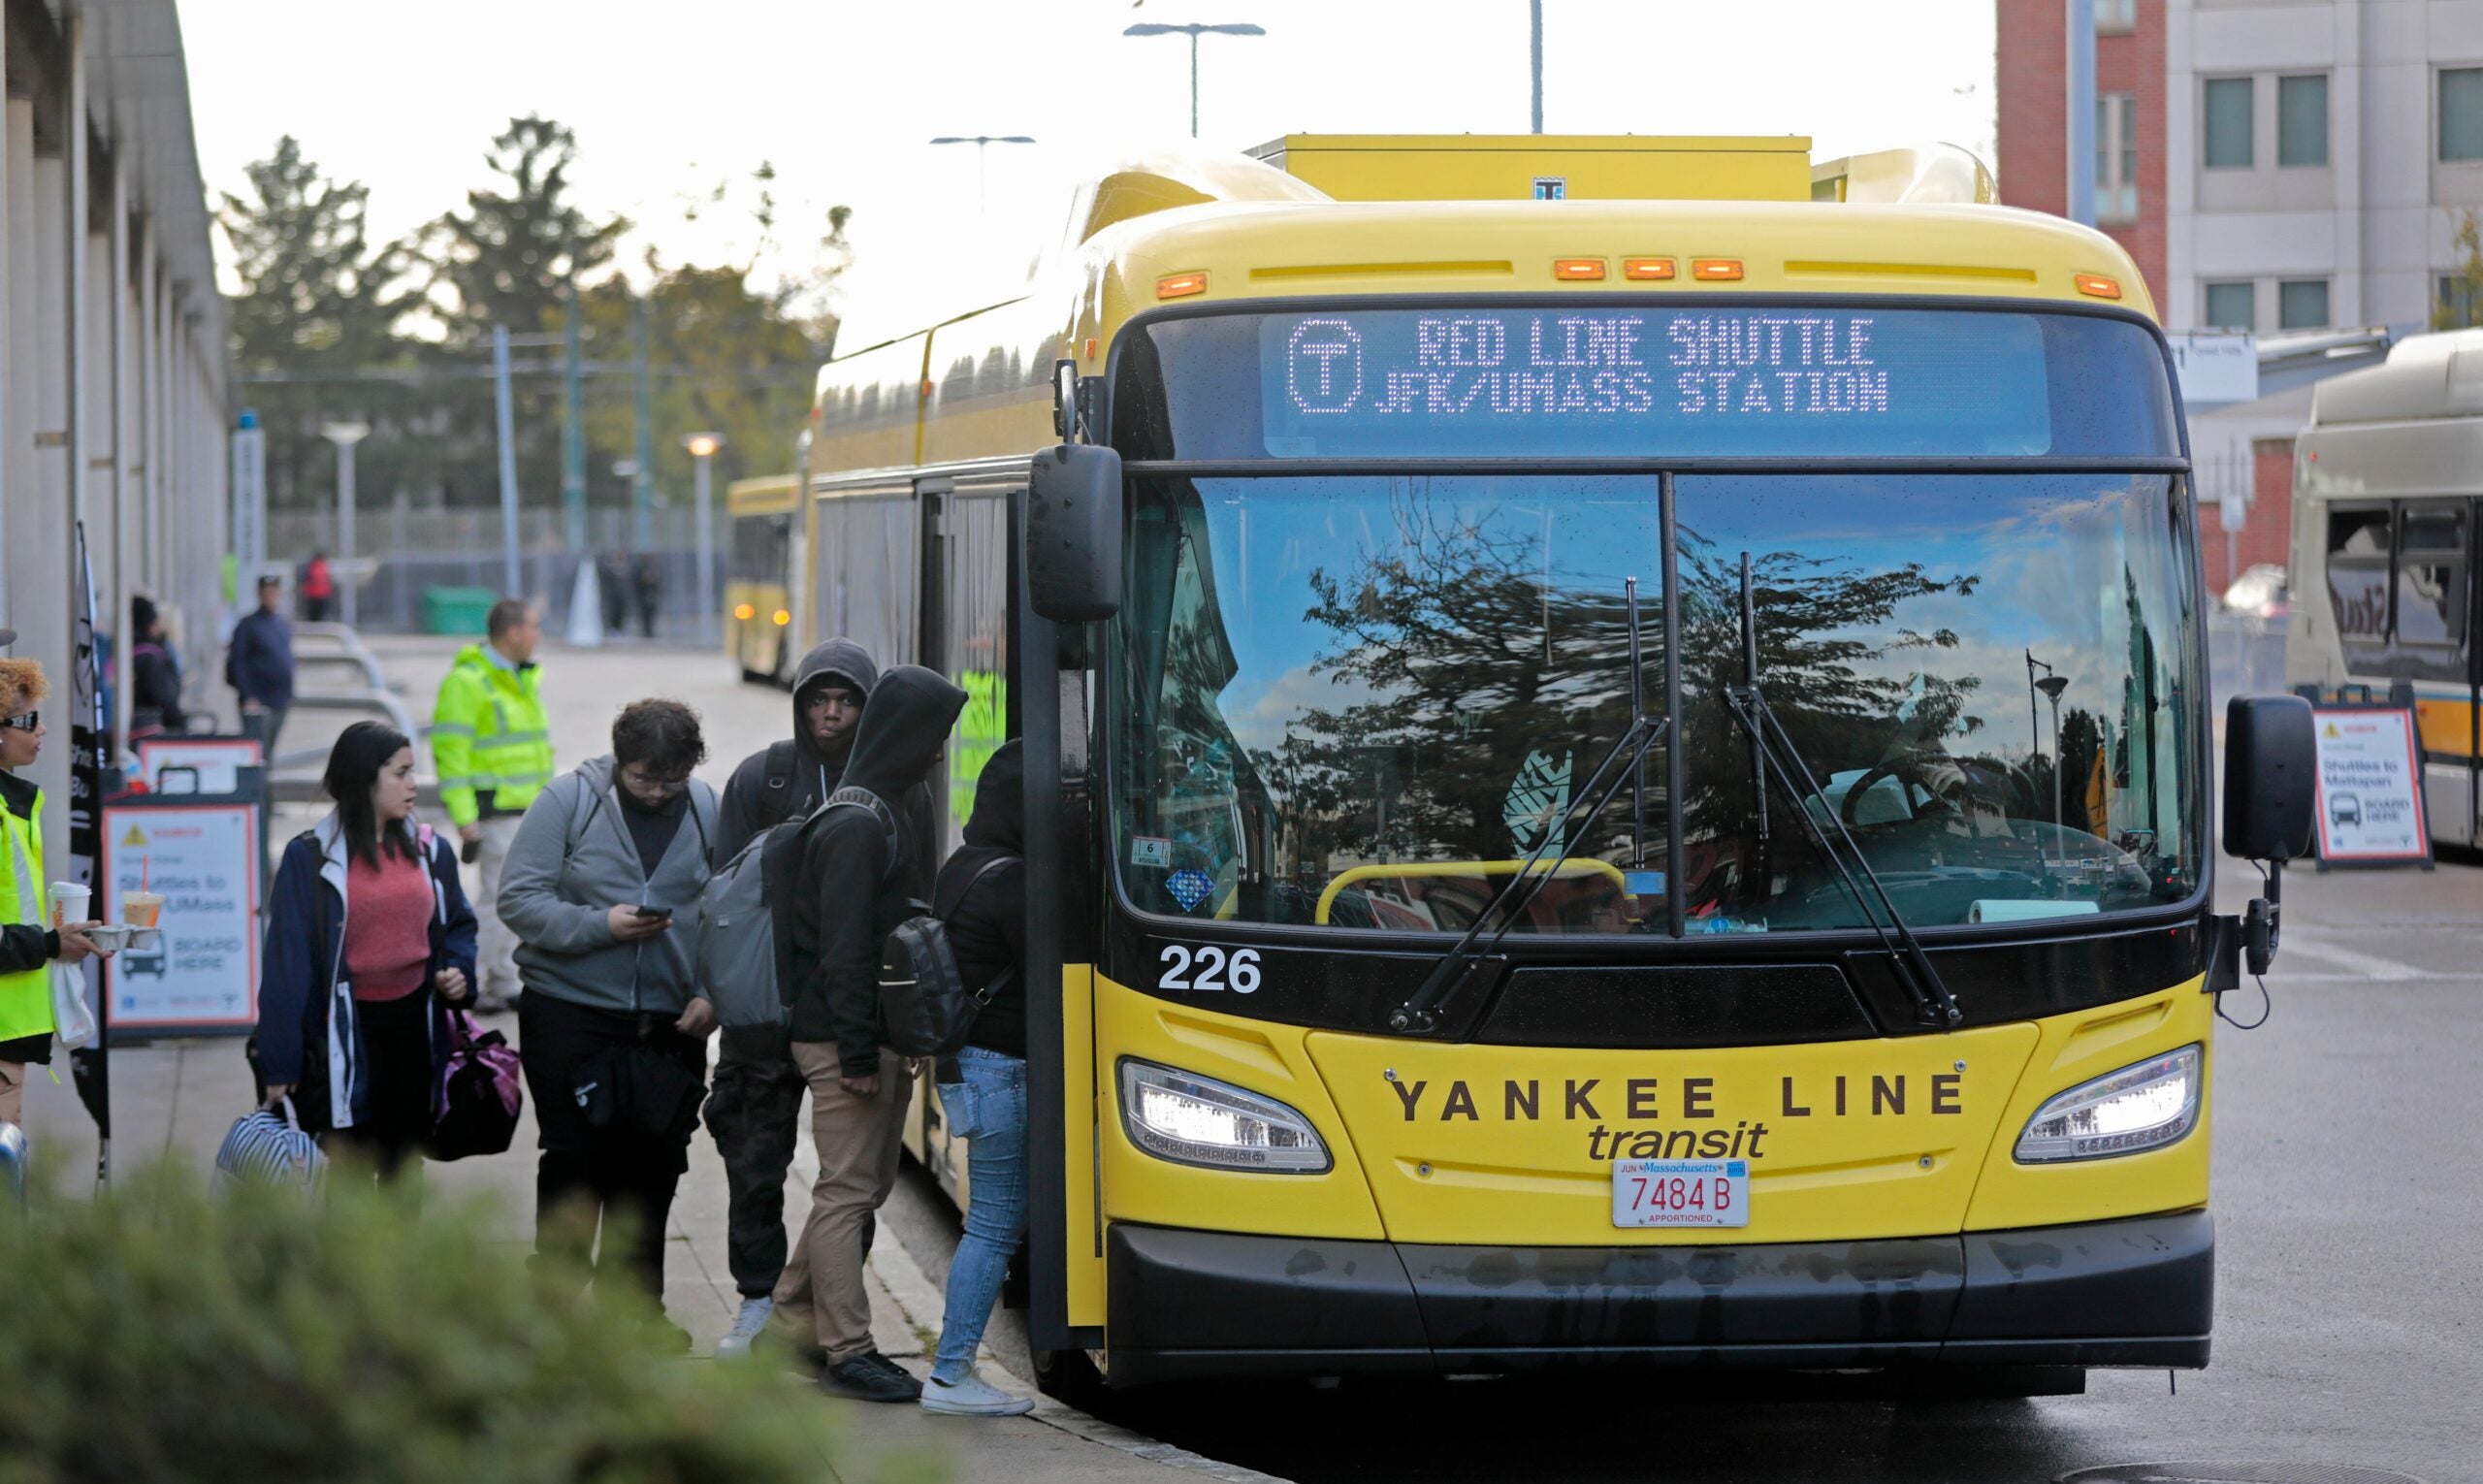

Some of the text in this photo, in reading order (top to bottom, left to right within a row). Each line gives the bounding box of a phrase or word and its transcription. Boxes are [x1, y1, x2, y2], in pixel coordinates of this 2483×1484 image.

[1419, 318, 1874, 366] RED LINE SHUTTLE
[1373, 371, 1887, 413] JFK/UMASS STATION
[1146, 843, 1154, 854] 6
[1159, 945, 1261, 994] 226
[1391, 1074, 1962, 1121] YANKEE LINE
[1587, 1120, 1769, 1160] transit
[1643, 1162, 1719, 1174] Massachusetts
[1631, 1178, 1730, 1210] 7484 B
